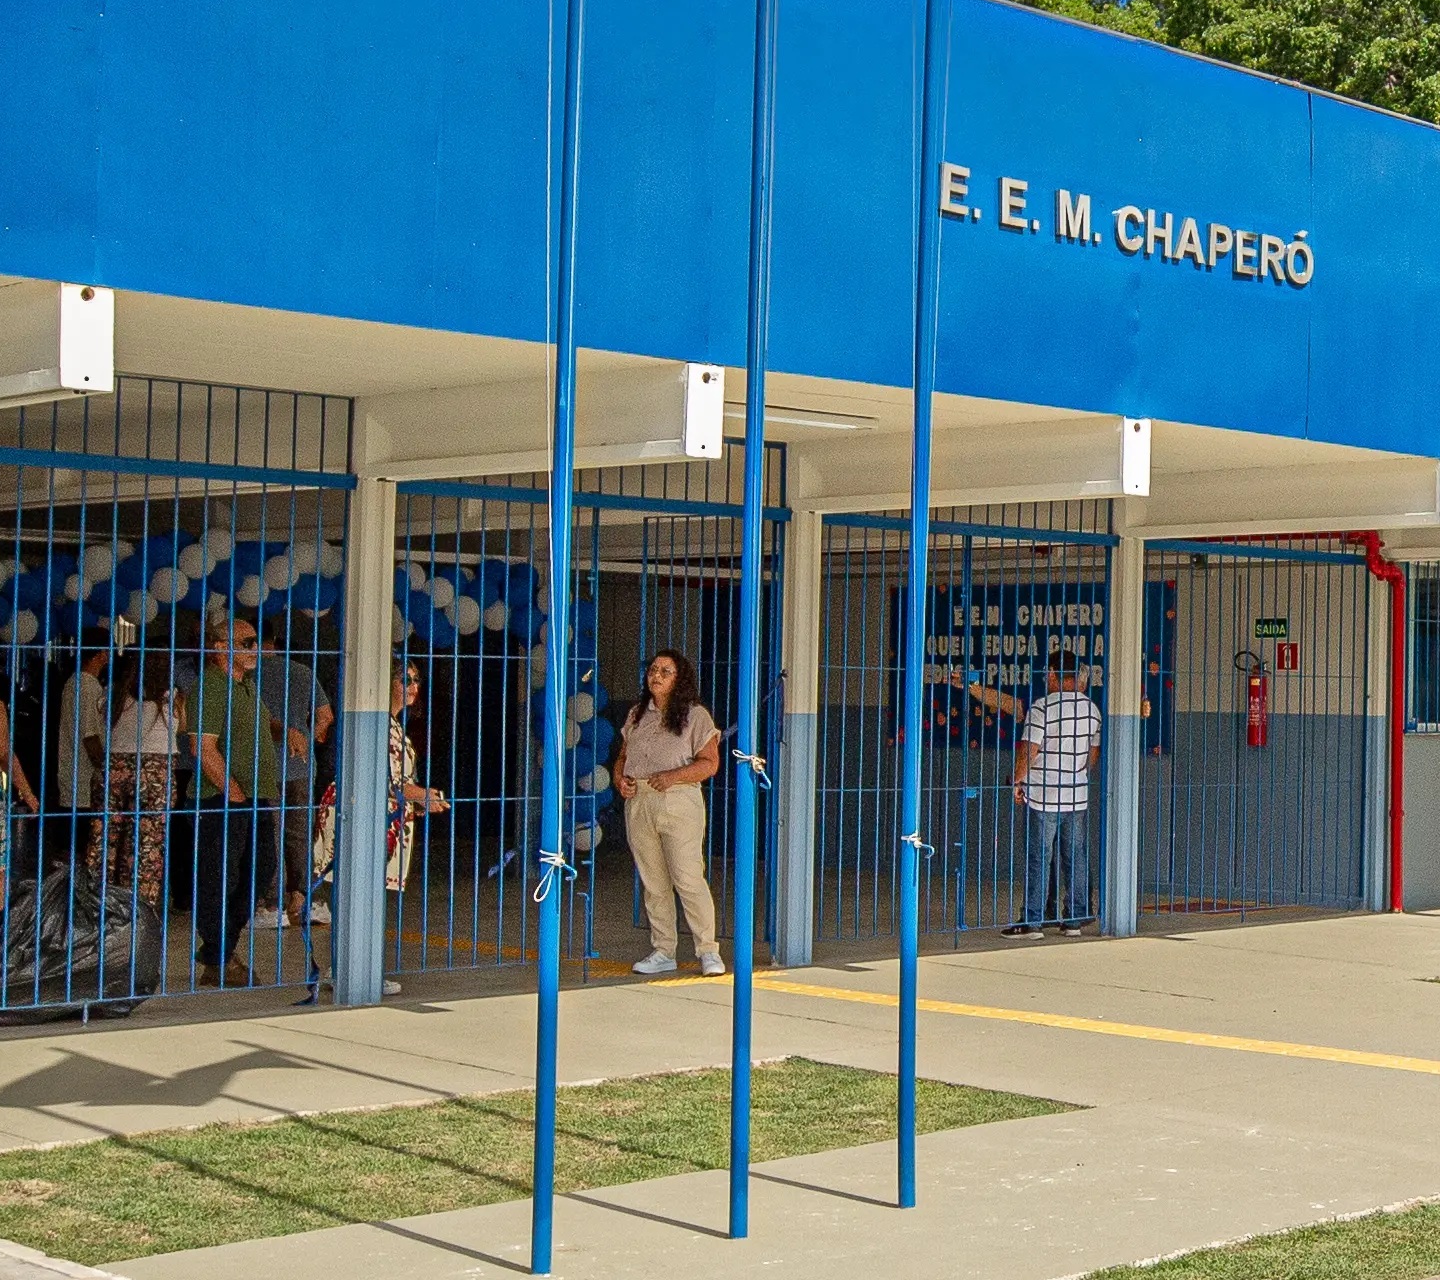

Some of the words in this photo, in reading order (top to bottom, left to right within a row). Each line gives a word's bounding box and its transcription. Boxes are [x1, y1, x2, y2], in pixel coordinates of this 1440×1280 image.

[939, 161, 982, 221] E.
[998, 176, 1040, 232] E.
[1055, 188, 1102, 244] M.
[1113, 205, 1315, 286] CHAPERÓ
[1256, 622, 1286, 635] SAÍDA
[982, 634, 1039, 657] EDUCA
